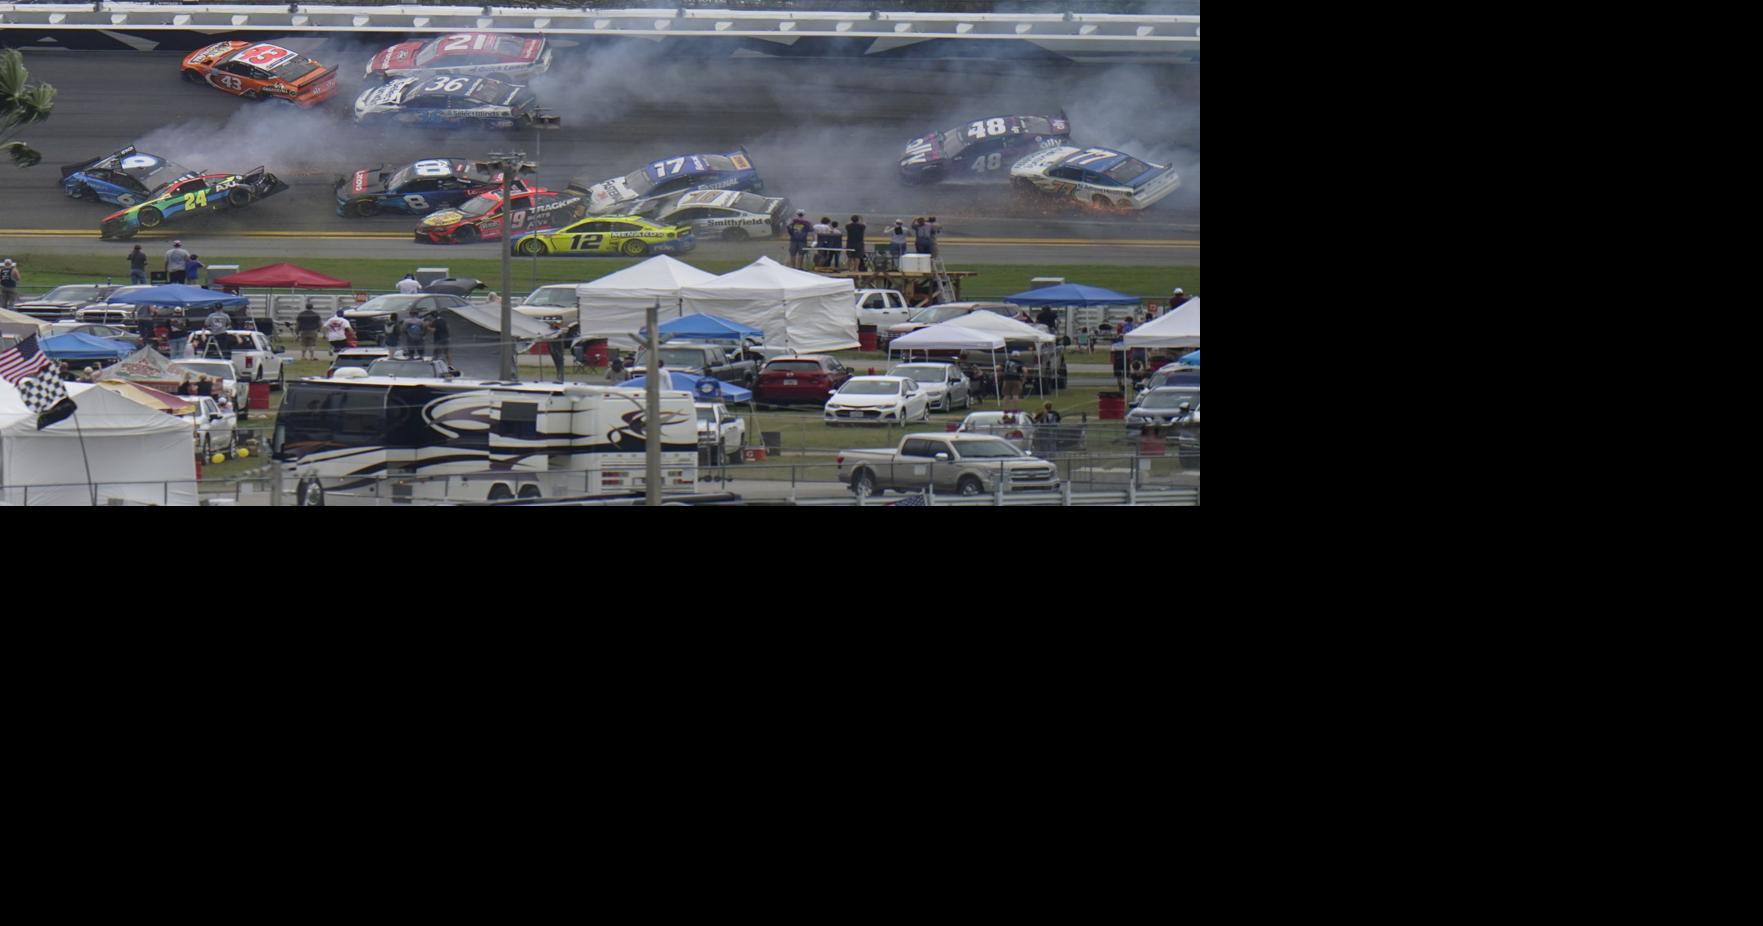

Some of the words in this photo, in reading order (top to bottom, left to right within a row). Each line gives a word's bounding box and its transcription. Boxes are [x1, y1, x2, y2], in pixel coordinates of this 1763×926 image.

[444, 34, 486, 51] 21
[240, 45, 288, 65] 43
[221, 75, 242, 90] 43
[424, 76, 469, 92] 36
[967, 117, 1007, 139] 48
[654, 157, 685, 178] 17
[970, 152, 1002, 174] 48
[184, 190, 207, 211] 24
[403, 195, 430, 210] 8
[707, 218, 762, 227] Smithfield
[570, 233, 604, 250] 12
